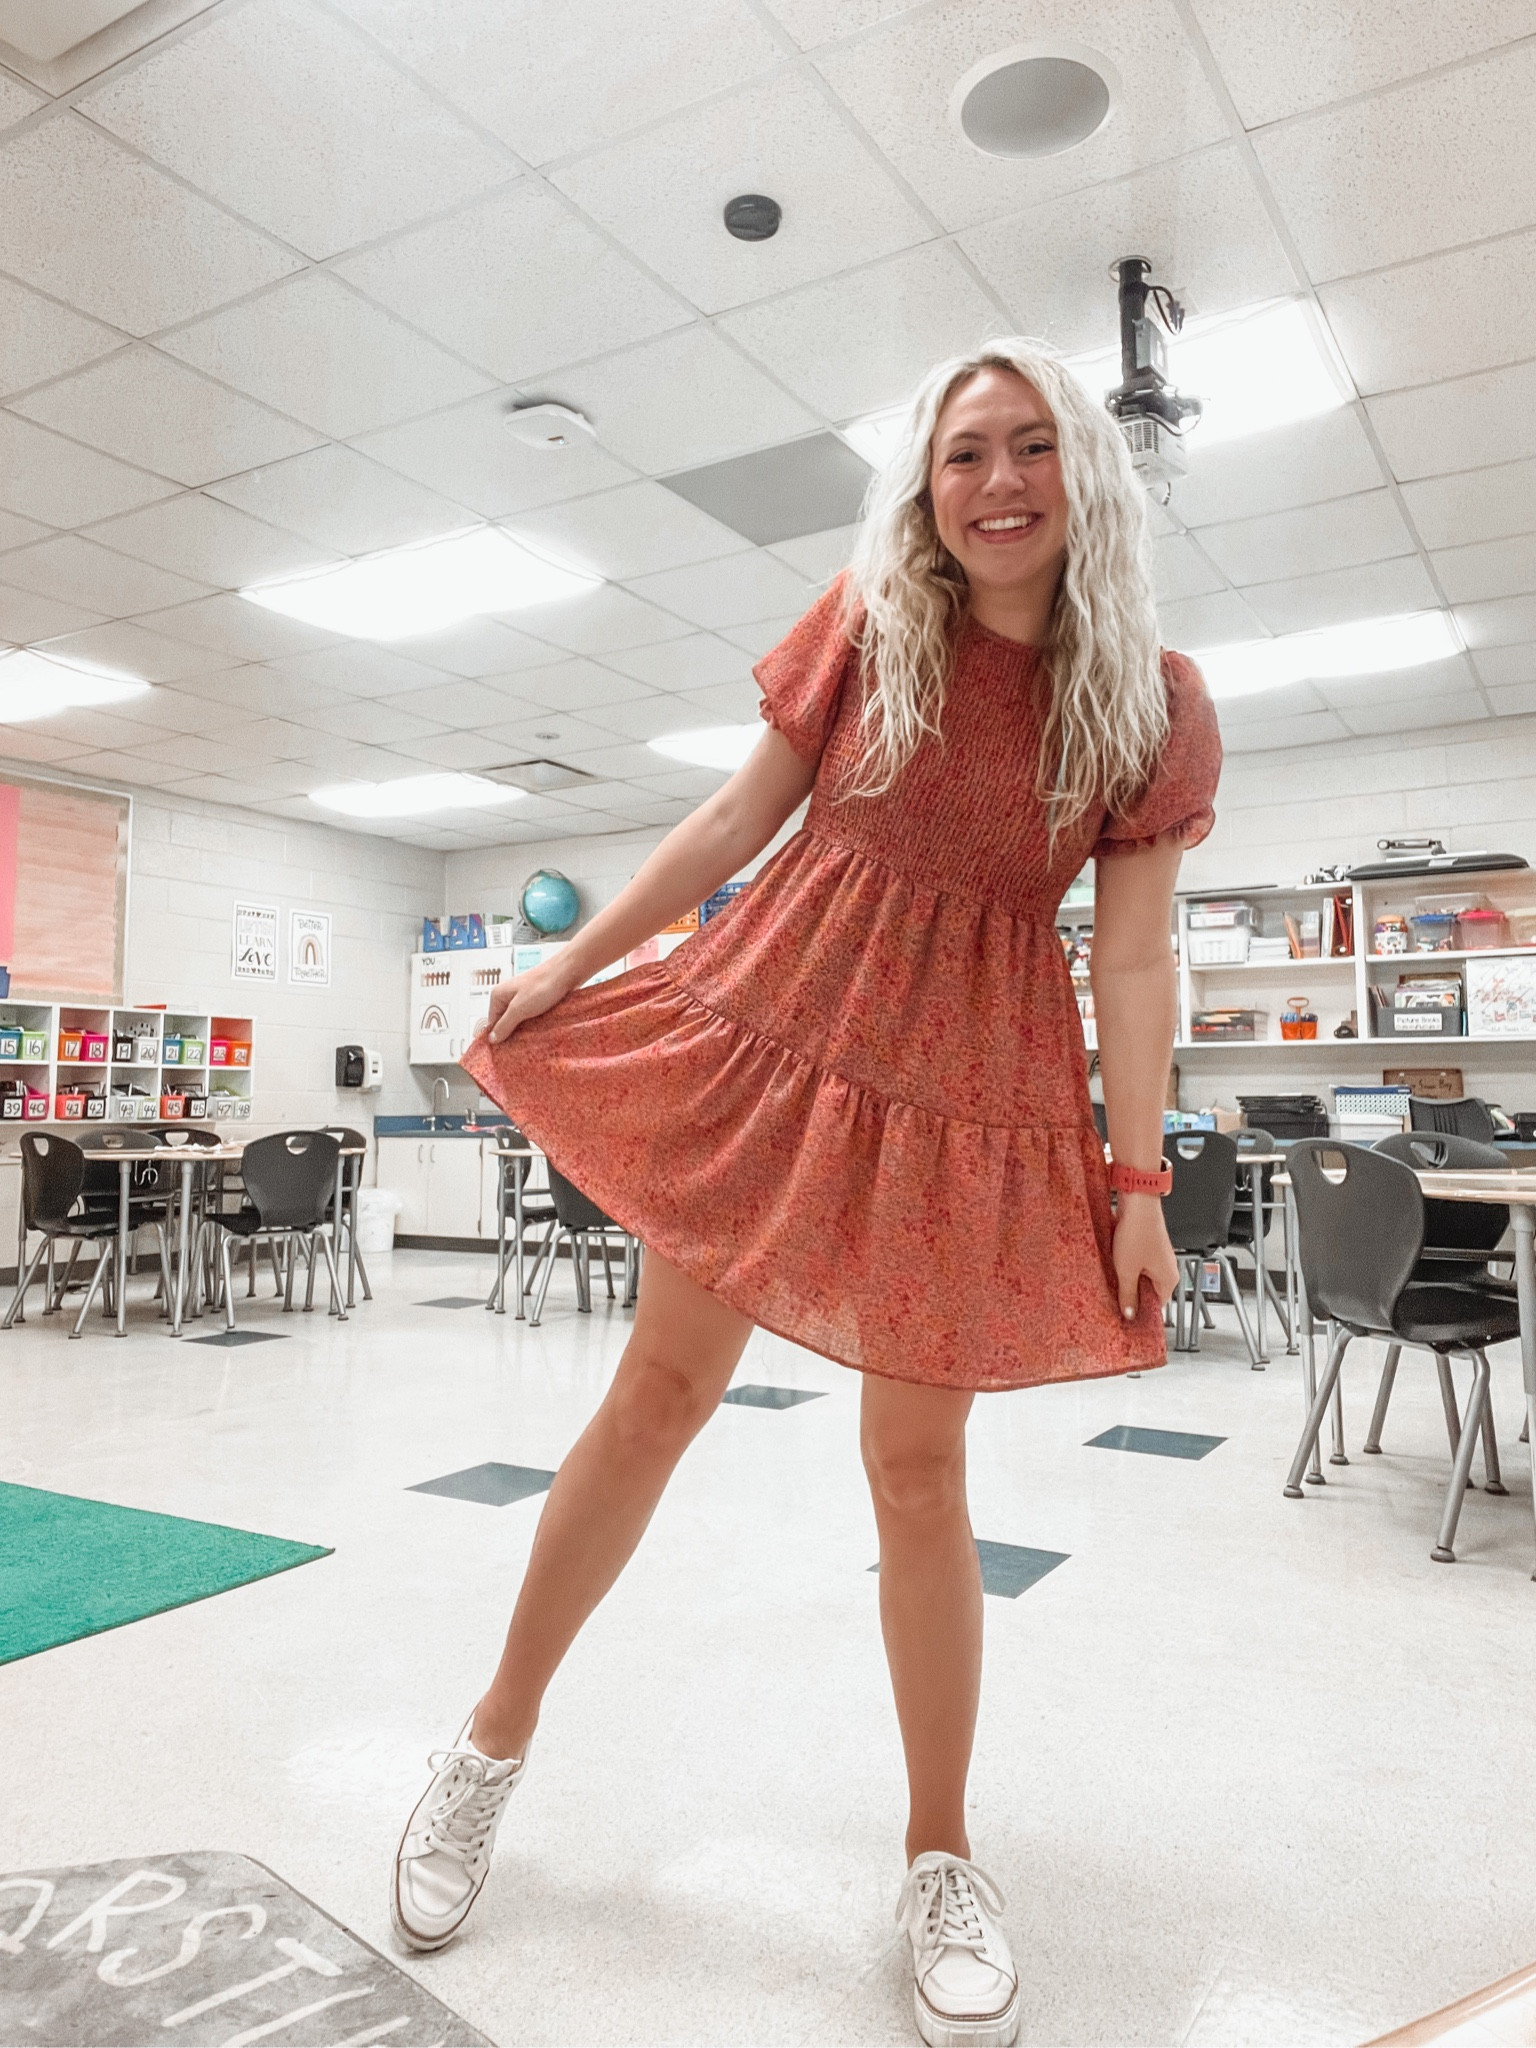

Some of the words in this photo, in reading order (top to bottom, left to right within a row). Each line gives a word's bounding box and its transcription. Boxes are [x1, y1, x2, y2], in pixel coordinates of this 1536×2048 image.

[3, 1040, 15, 1054] 15
[29, 1040, 40, 1055] 16
[66, 1042, 78, 1057] 17
[91, 1043, 102, 1057] 18
[119, 1044, 129, 1058] 19
[140, 1047, 155, 1059] 20
[167, 1047, 178, 1059] 21
[187, 1048, 201, 1060] 22
[213, 1049, 226, 1059] 23
[235, 1051, 247, 1061] 24
[4, 1102, 20, 1115] 39
[29, 1102, 45, 1114] 40
[66, 1103, 79, 1115] 41
[89, 1103, 103, 1114] 42
[120, 1103, 134, 1116] 43
[143, 1103, 156, 1115] 44
[167, 1101, 180, 1114] 45
[192, 1102, 205, 1114] 46
[218, 1103, 231, 1115] 47
[238, 1103, 250, 1114] 48
